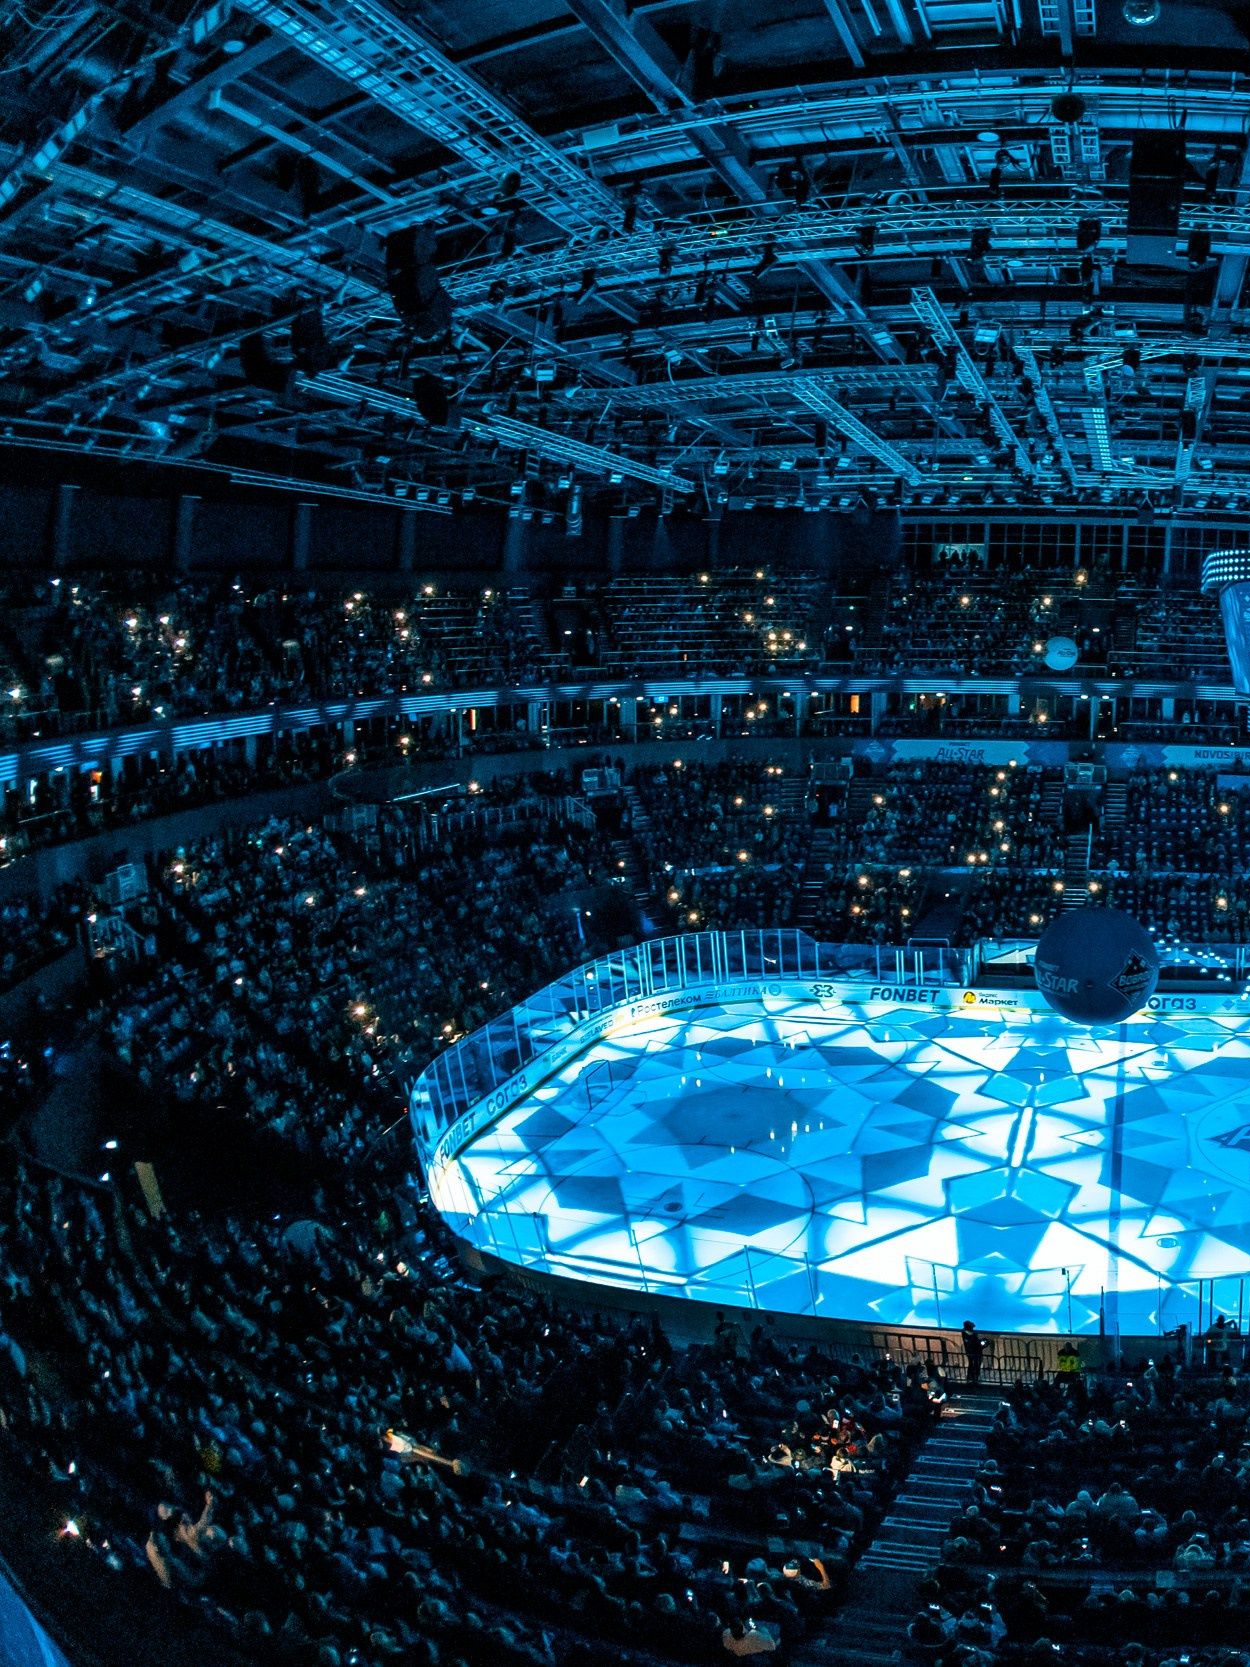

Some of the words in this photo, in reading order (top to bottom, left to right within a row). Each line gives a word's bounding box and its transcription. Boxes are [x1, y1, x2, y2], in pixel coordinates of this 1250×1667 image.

[637, 994, 702, 1016] Ростелеком
[870, 987, 940, 1003] FONBET
[440, 1111, 476, 1160] FONBET
